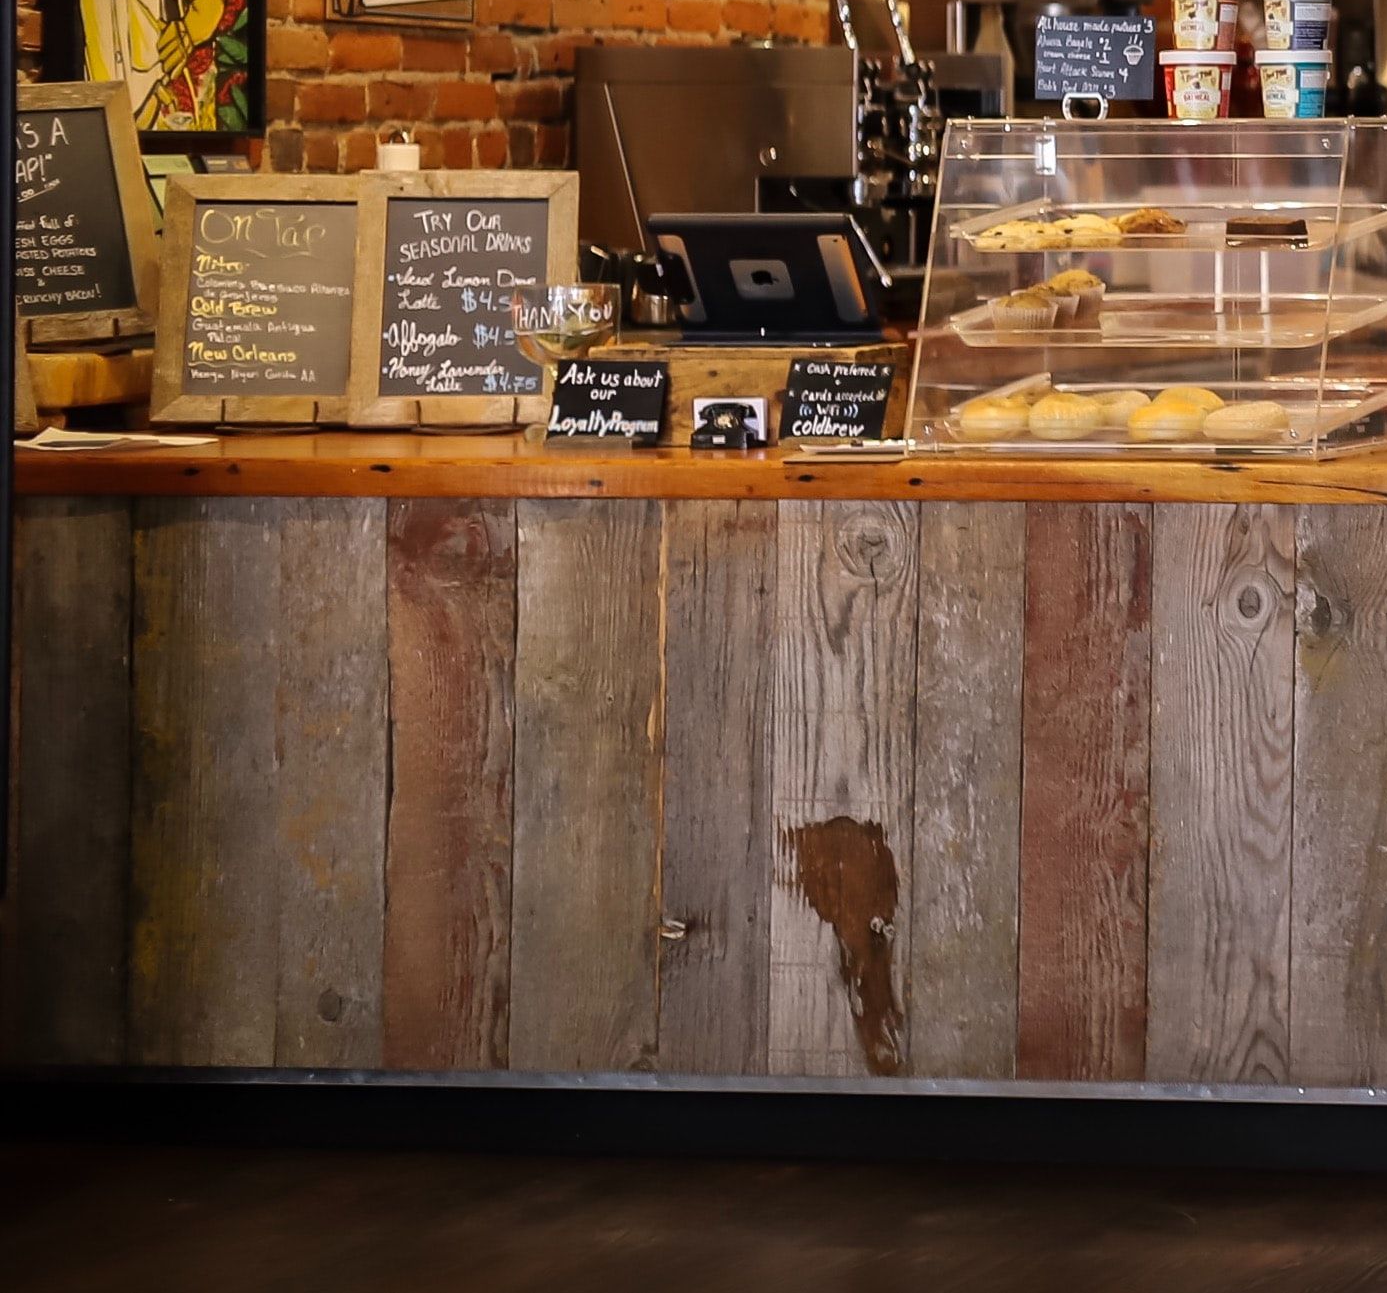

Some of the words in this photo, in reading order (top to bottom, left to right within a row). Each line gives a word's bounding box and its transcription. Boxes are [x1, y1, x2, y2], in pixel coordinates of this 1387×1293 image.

[1054, 16, 1080, 33] house
[49, 116, 70, 146] A
[201, 209, 252, 244] On
[41, 234, 75, 246] EGGS
[400, 234, 479, 263] SEASONAL
[485, 232, 532, 255] DRINKS
[41, 265, 85, 276] CHEESE
[441, 266, 491, 288] Lemon
[190, 296, 225, 316] Cold
[228, 301, 278, 316] Brew
[188, 340, 228, 362] New
[232, 343, 297, 363] Orleans
[388, 357, 432, 384] Honey
[437, 359, 505, 379] Lavender
[560, 362, 597, 386] Ask
[601, 372, 620, 388] us
[623, 368, 664, 389] about
[590, 388, 617, 401] our
